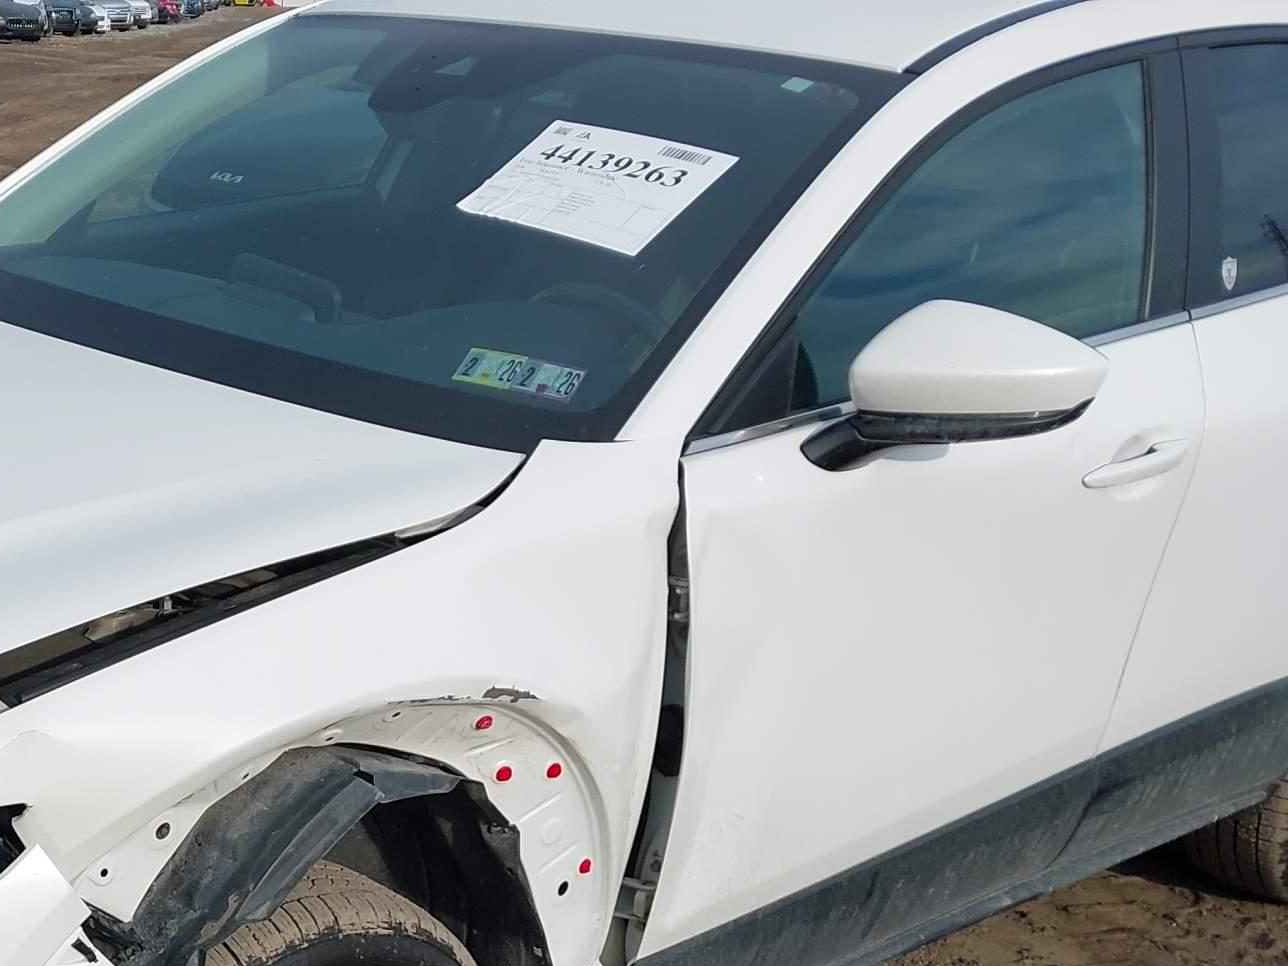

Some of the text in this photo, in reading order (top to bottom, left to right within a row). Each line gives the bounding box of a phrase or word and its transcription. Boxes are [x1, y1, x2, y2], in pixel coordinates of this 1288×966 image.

[540, 144, 688, 187] 44139263
[462, 357, 523, 382] 2 26
[519, 366, 581, 396] 2 26
